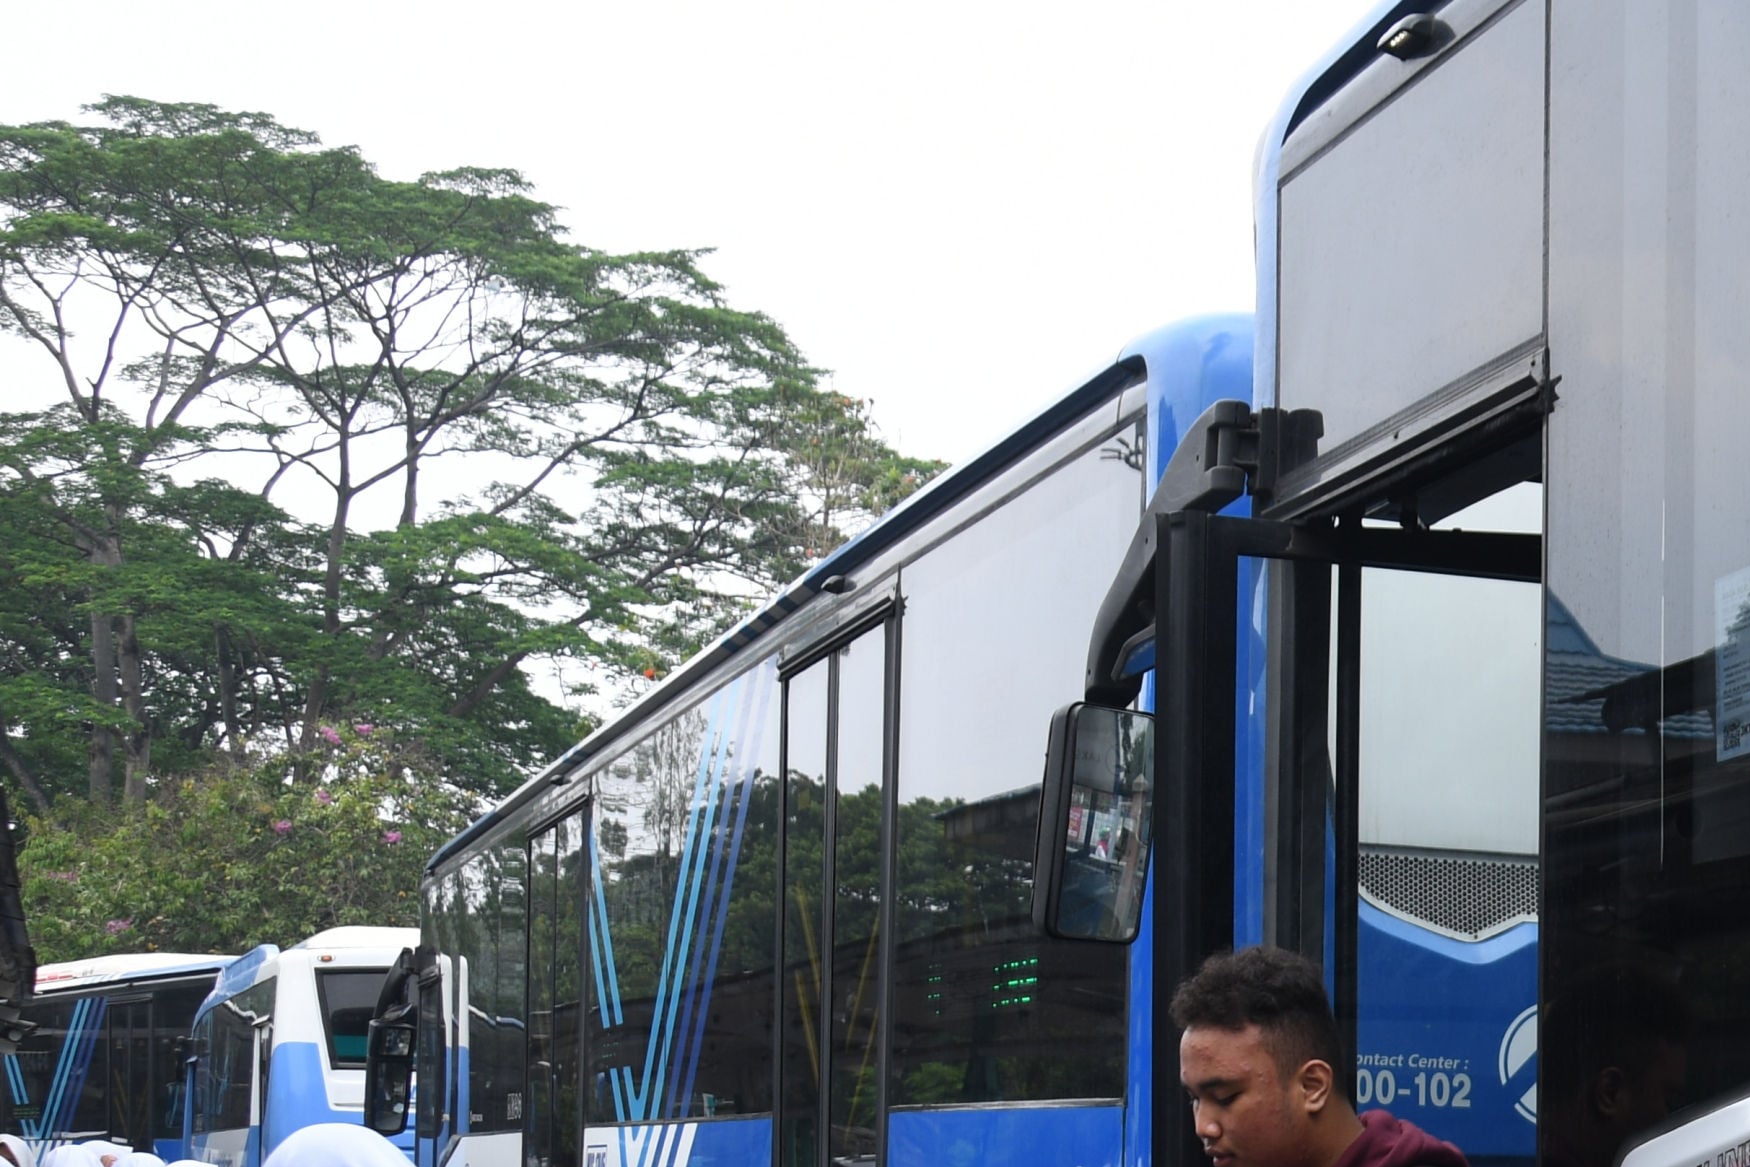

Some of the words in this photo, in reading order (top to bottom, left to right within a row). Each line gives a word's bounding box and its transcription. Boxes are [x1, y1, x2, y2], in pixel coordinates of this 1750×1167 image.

[1357, 1053, 1403, 1067] ontact
[1408, 1054, 1460, 1069] Center
[1357, 1069, 1472, 1108] 00-102
